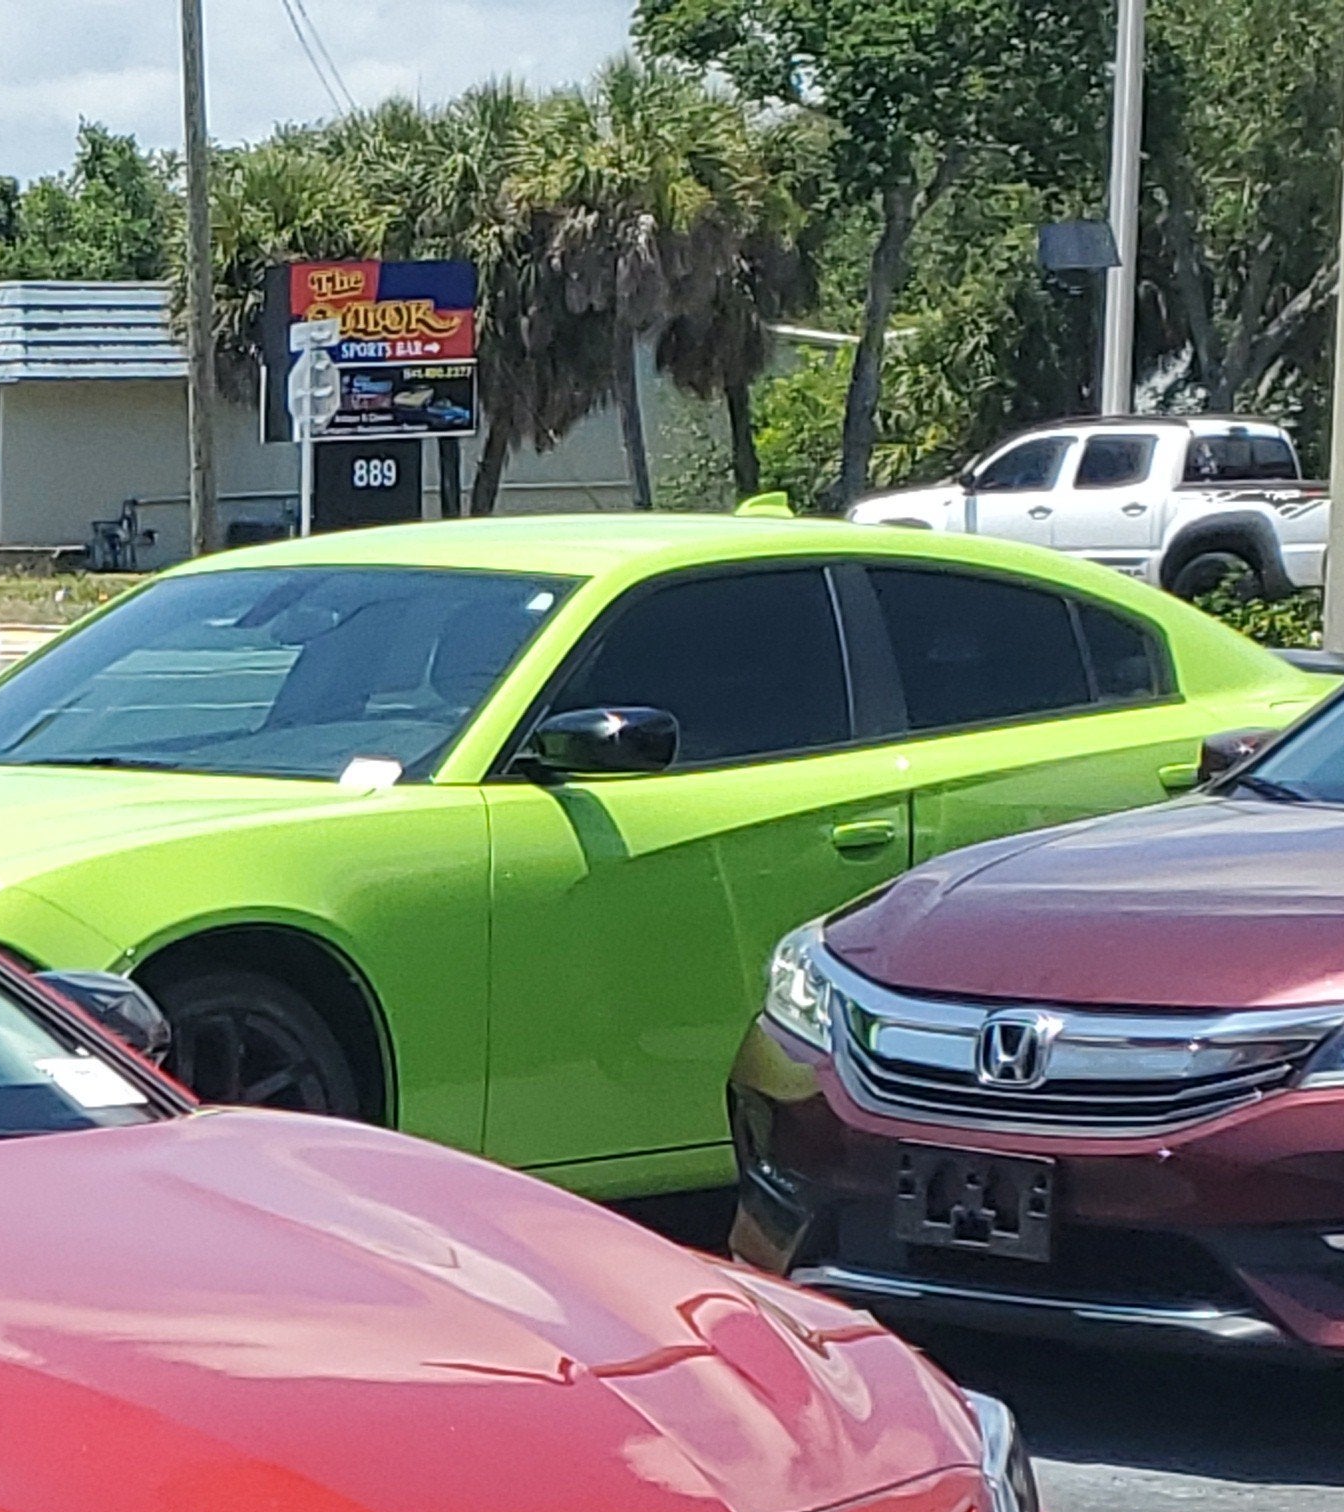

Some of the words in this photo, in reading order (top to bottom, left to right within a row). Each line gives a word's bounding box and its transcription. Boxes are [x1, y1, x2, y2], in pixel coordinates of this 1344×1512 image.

[308, 268, 364, 299] The
[341, 341, 392, 359] SPORTS
[395, 340, 424, 357] BAR
[354, 459, 397, 487] 889
